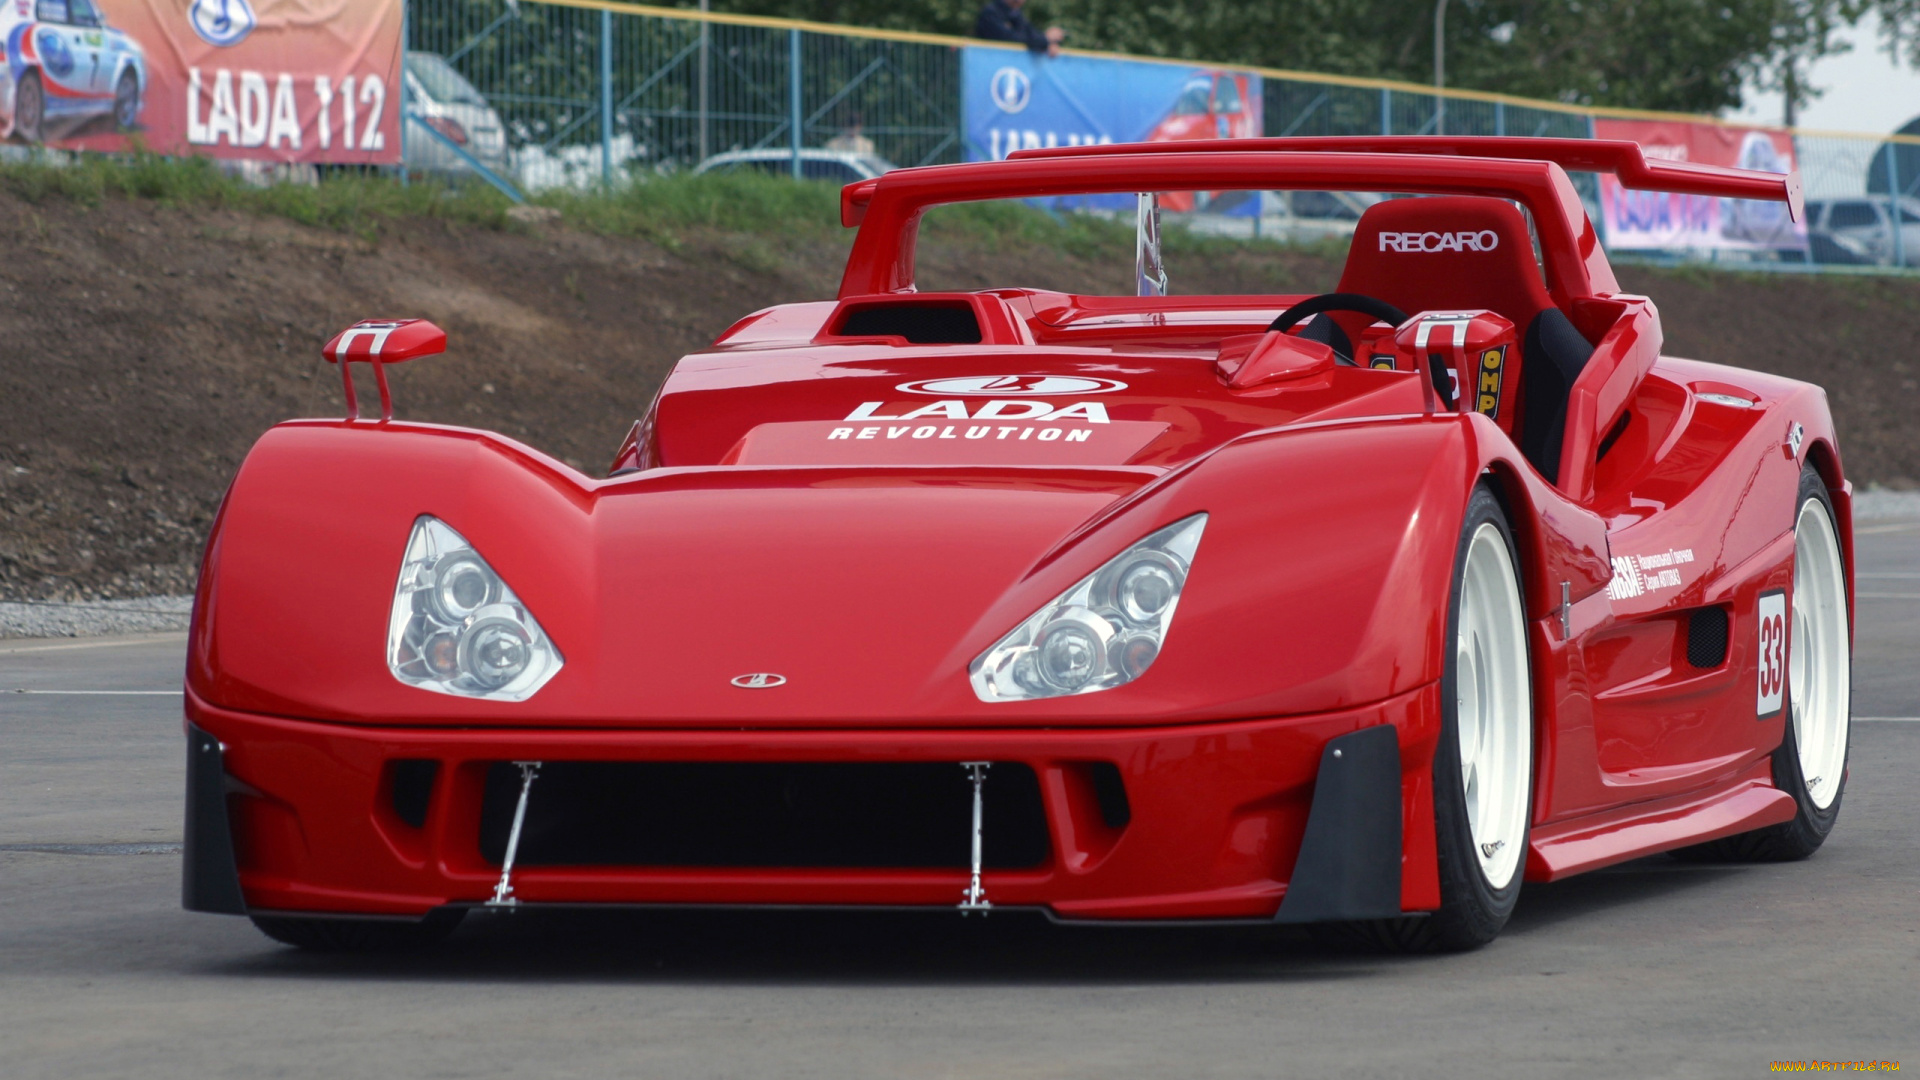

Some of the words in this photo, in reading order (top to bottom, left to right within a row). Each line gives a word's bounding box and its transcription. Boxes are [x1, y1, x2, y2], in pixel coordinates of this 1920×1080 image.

[187, 66, 302, 149] LADA
[314, 73, 386, 150] 112
[1379, 230, 1499, 253] RECARO
[1478, 350, 1501, 414] OMP
[827, 426, 1093, 442] REVOLUTION
[842, 400, 1110, 424] LADA
[1760, 613, 1783, 698] 33
